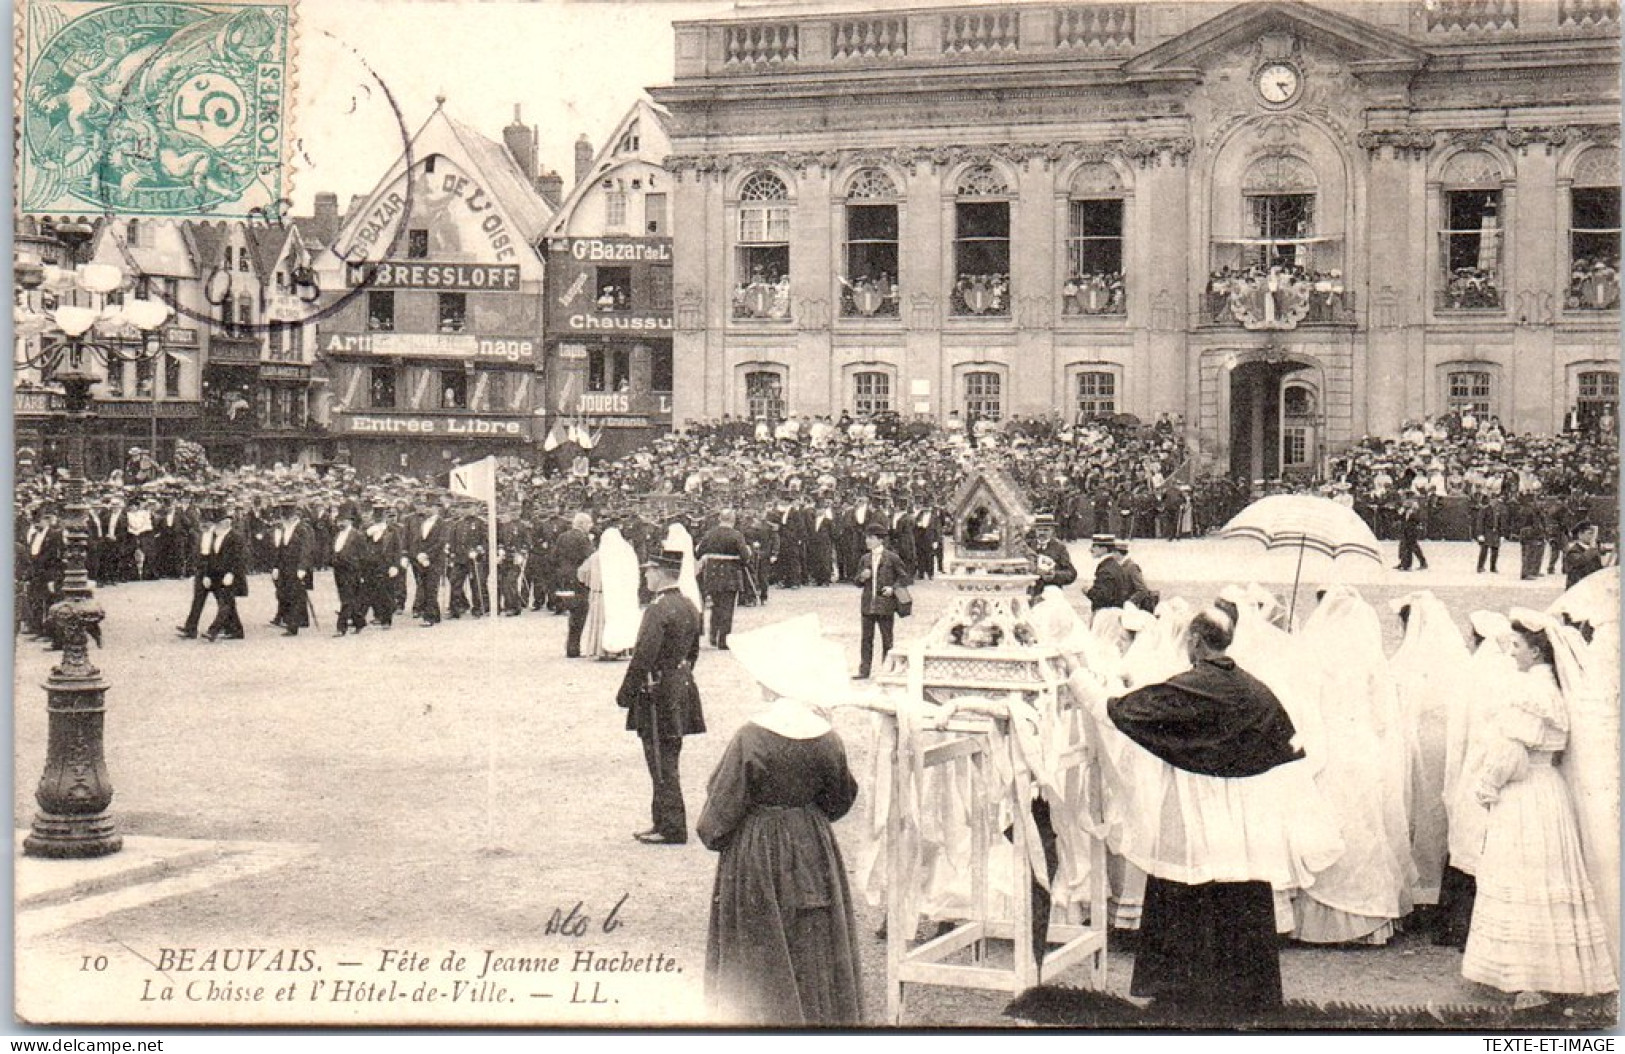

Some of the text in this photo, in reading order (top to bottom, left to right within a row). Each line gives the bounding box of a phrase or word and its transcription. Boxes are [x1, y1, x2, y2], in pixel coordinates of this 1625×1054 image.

[257, 66, 280, 159] POSTES
[442, 174, 469, 198] DE
[359, 192, 405, 244] BAZAR
[590, 240, 645, 260] Bazar
[376, 266, 519, 288] BRESSLOFF
[479, 340, 533, 361] nage
[576, 394, 629, 413] Jouets
[350, 416, 521, 434] Entrée Libre
[454, 471, 468, 491] N
